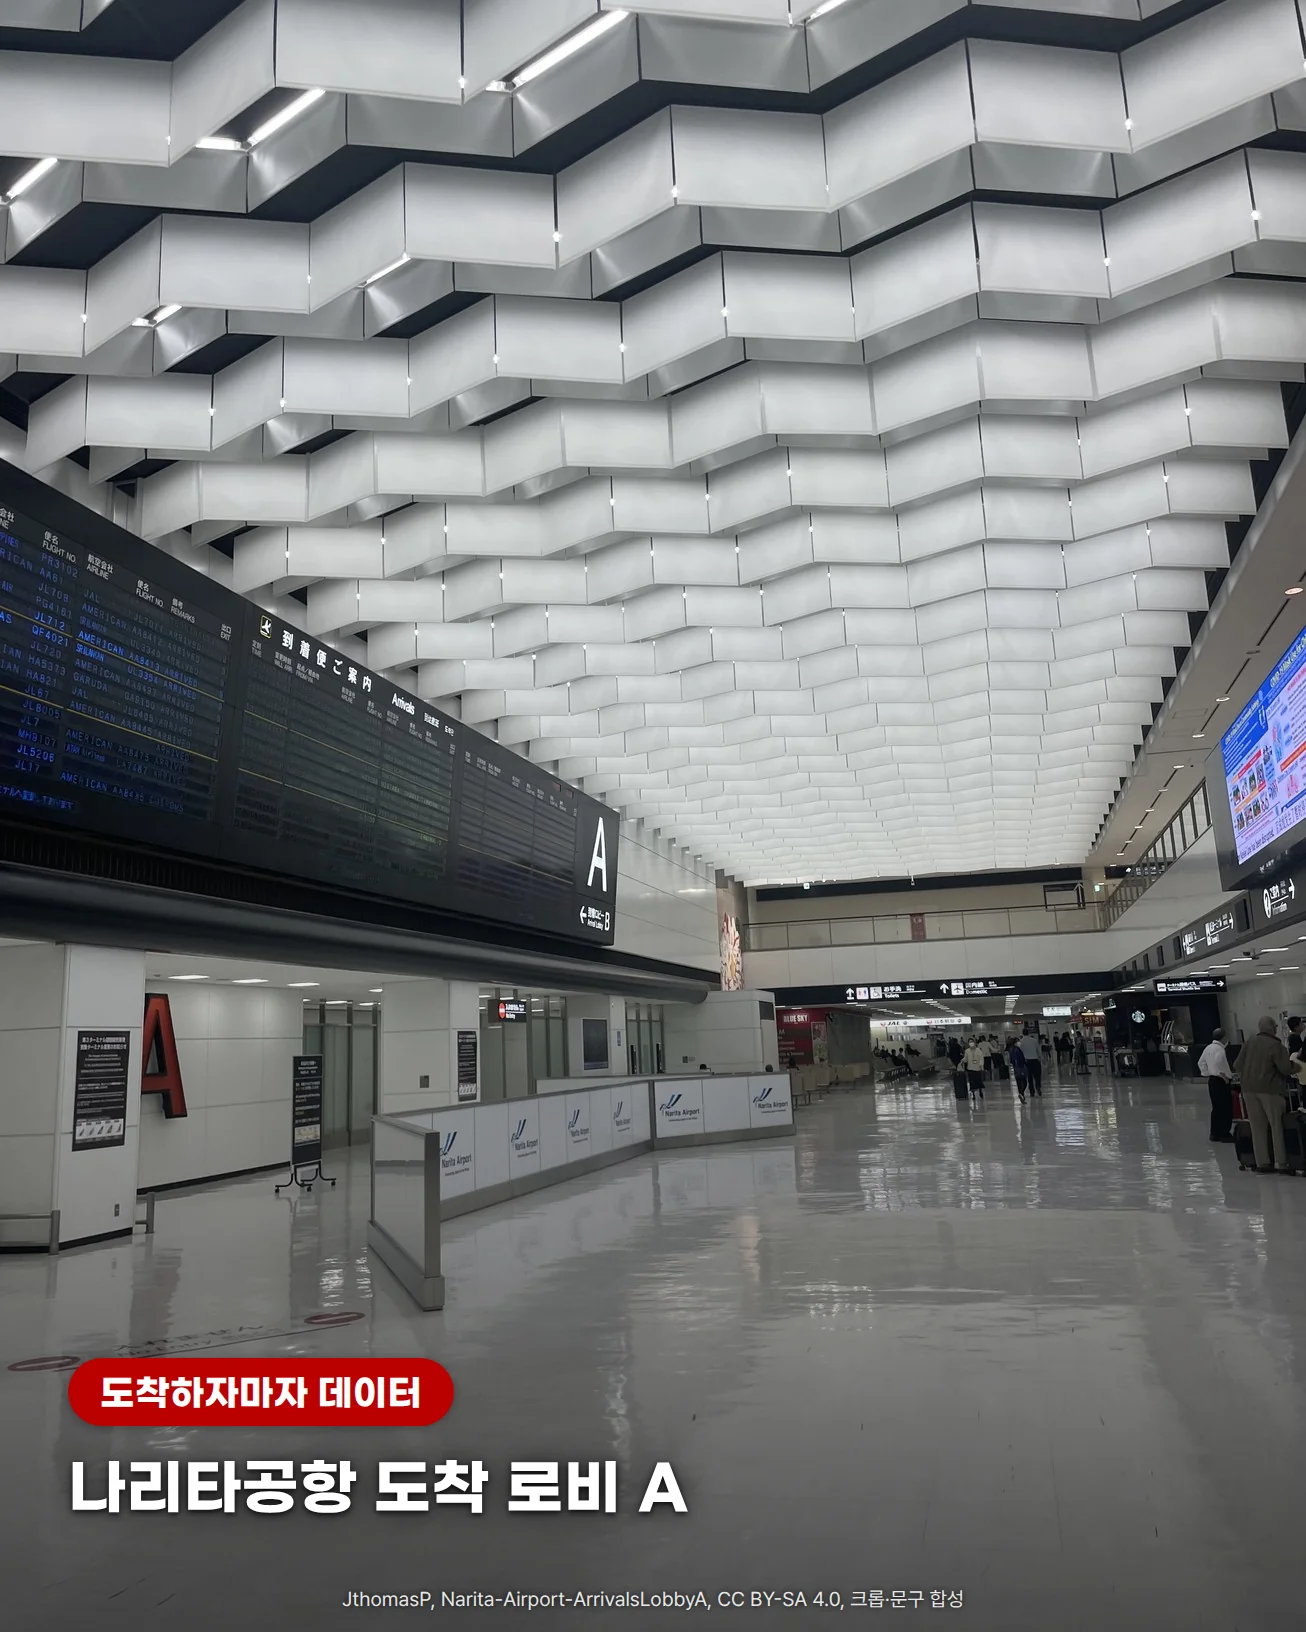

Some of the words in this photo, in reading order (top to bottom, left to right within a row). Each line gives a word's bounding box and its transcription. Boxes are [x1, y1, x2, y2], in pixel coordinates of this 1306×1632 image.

[43, 540, 65, 557] FLIGHT
[66, 552, 77, 563] NO.
[86, 563, 109, 580] AIRLINE
[135, 588, 154, 604] FLIGHT
[81, 603, 126, 630] AMERICAN
[170, 606, 195, 623] REMARKS
[32, 625, 69, 647] QF4021
[34, 612, 65, 631] JL712
[78, 630, 125, 657] AMERICAN
[74, 658, 121, 683] AMERICAN
[282, 629, 372, 693] 到着便ご案内
[73, 671, 108, 692] GARUDA
[69, 700, 115, 722] AMERICAN
[392, 693, 415, 715] Arrivals
[66, 729, 113, 751] AMERICAN
[60, 772, 107, 791] AMERICAN
[586, 816, 608, 893] A
[604, 911, 610, 931] B
[797, 1014, 808, 1022] SKY
[1084, 1017, 1100, 1025] SIM
[141, 993, 188, 1119] A
[682, 1108, 700, 1116] Airport
[526, 1139, 538, 1149] Airport
[441, 1157, 456, 1168] Narita
[456, 1153, 472, 1166] Airport
